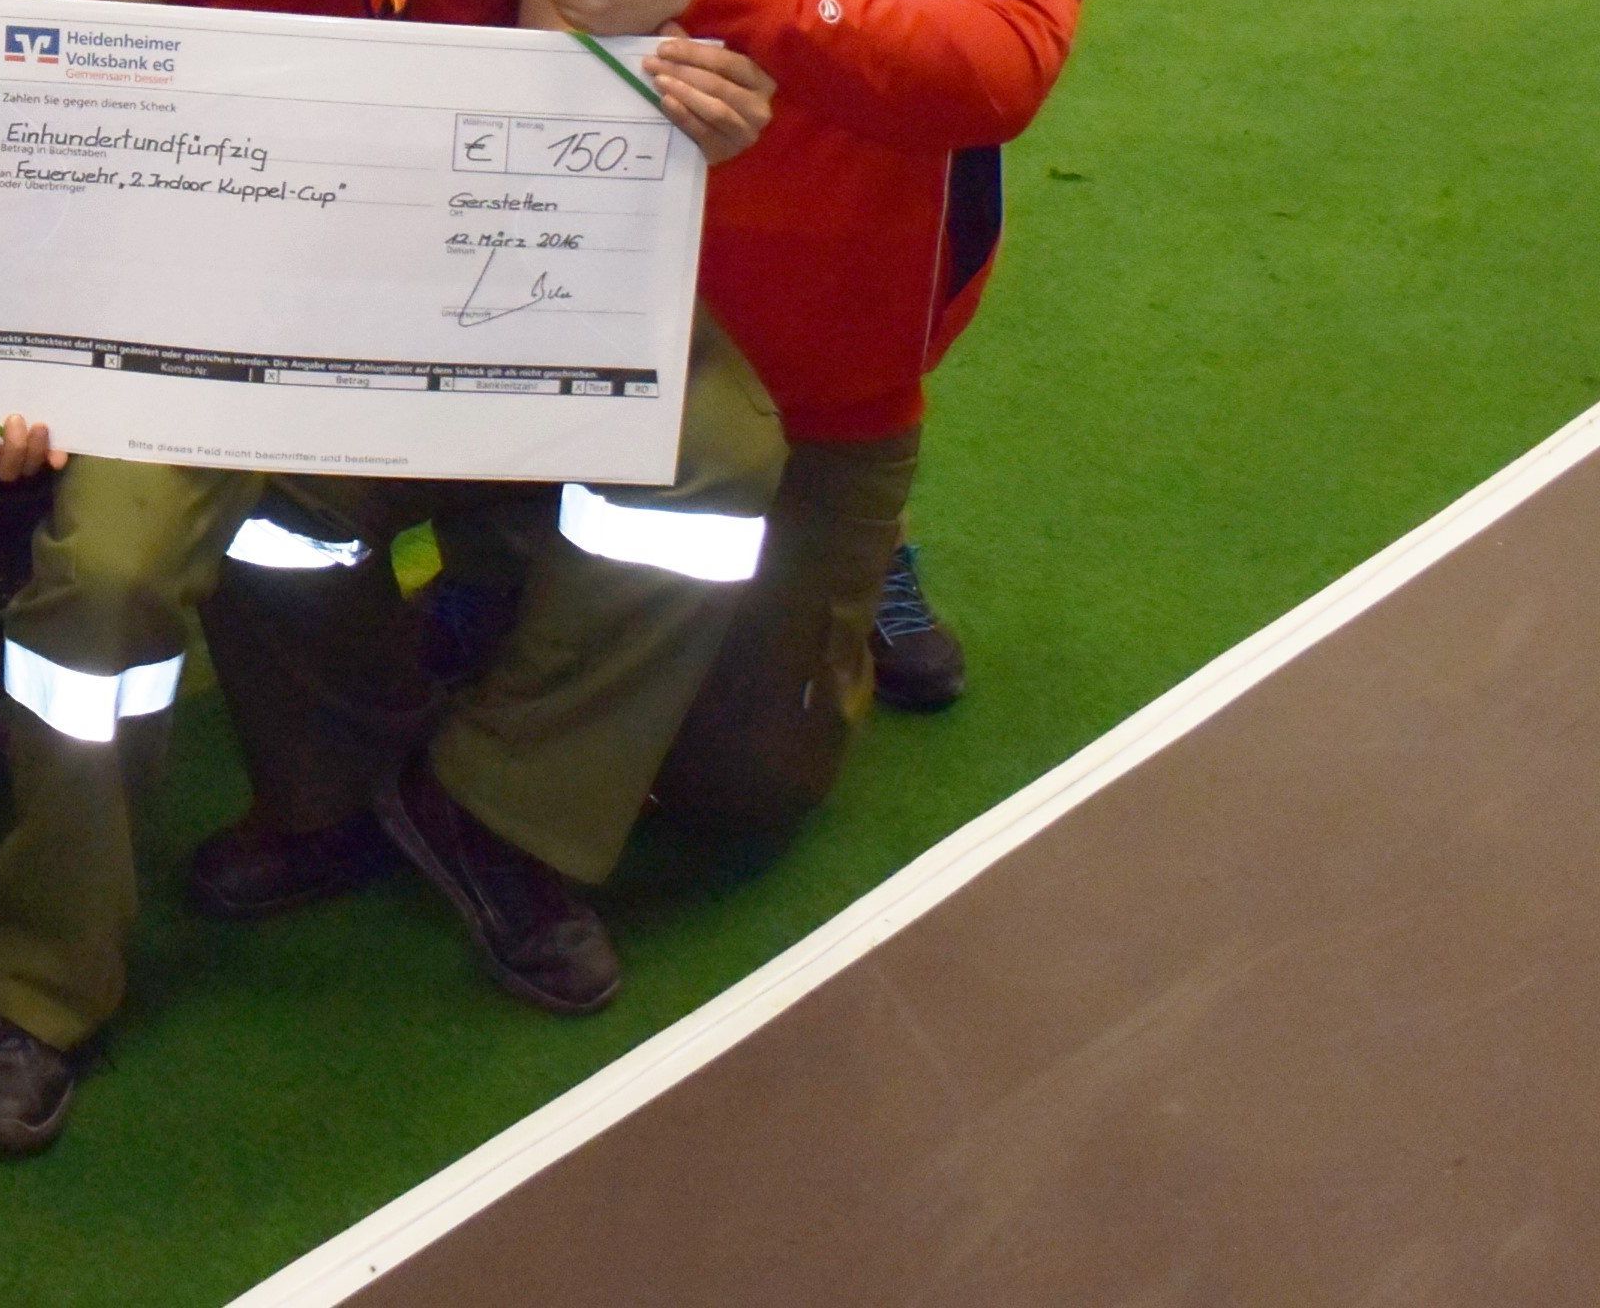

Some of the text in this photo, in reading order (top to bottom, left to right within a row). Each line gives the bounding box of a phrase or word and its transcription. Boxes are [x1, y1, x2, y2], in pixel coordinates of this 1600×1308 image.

[67, 31, 181, 52] Heidenheimer
[66, 52, 175, 72] Volksbank eG
[65, 68, 174, 84] Gemeinsam besser!
[2, 93, 177, 113] Zahlen Sie gegen diesen Scheck
[0, 143, 107, 158] Betrag in Buchstaben
[6, 122, 268, 172] Einhundertundfünfzig
[16, 160, 116, 187] Feuerwehr
[449, 192, 558, 212] Gerstetten
[478, 230, 526, 248] März
[536, 233, 585, 249] 2016
[25, 335, 72, 348] Schecktext
[74, 339, 93, 349] darf
[95, 343, 117, 352] nicht
[119, 345, 160, 357] geändert
[161, 350, 182, 359] oder
[184, 352, 232, 364] gestrichen
[273, 359, 288, 368] Die
[291, 360, 326, 371] Angabe
[454, 368, 484, 376] Scheck
[519, 369, 542, 377] nicht
[336, 375, 369, 387] Betrag
[128, 439, 153, 450] Bitte
[157, 443, 192, 454] dieses
[197, 446, 221, 457] Feld
[225, 448, 251, 459] nicht
[320, 453, 341, 463] und
